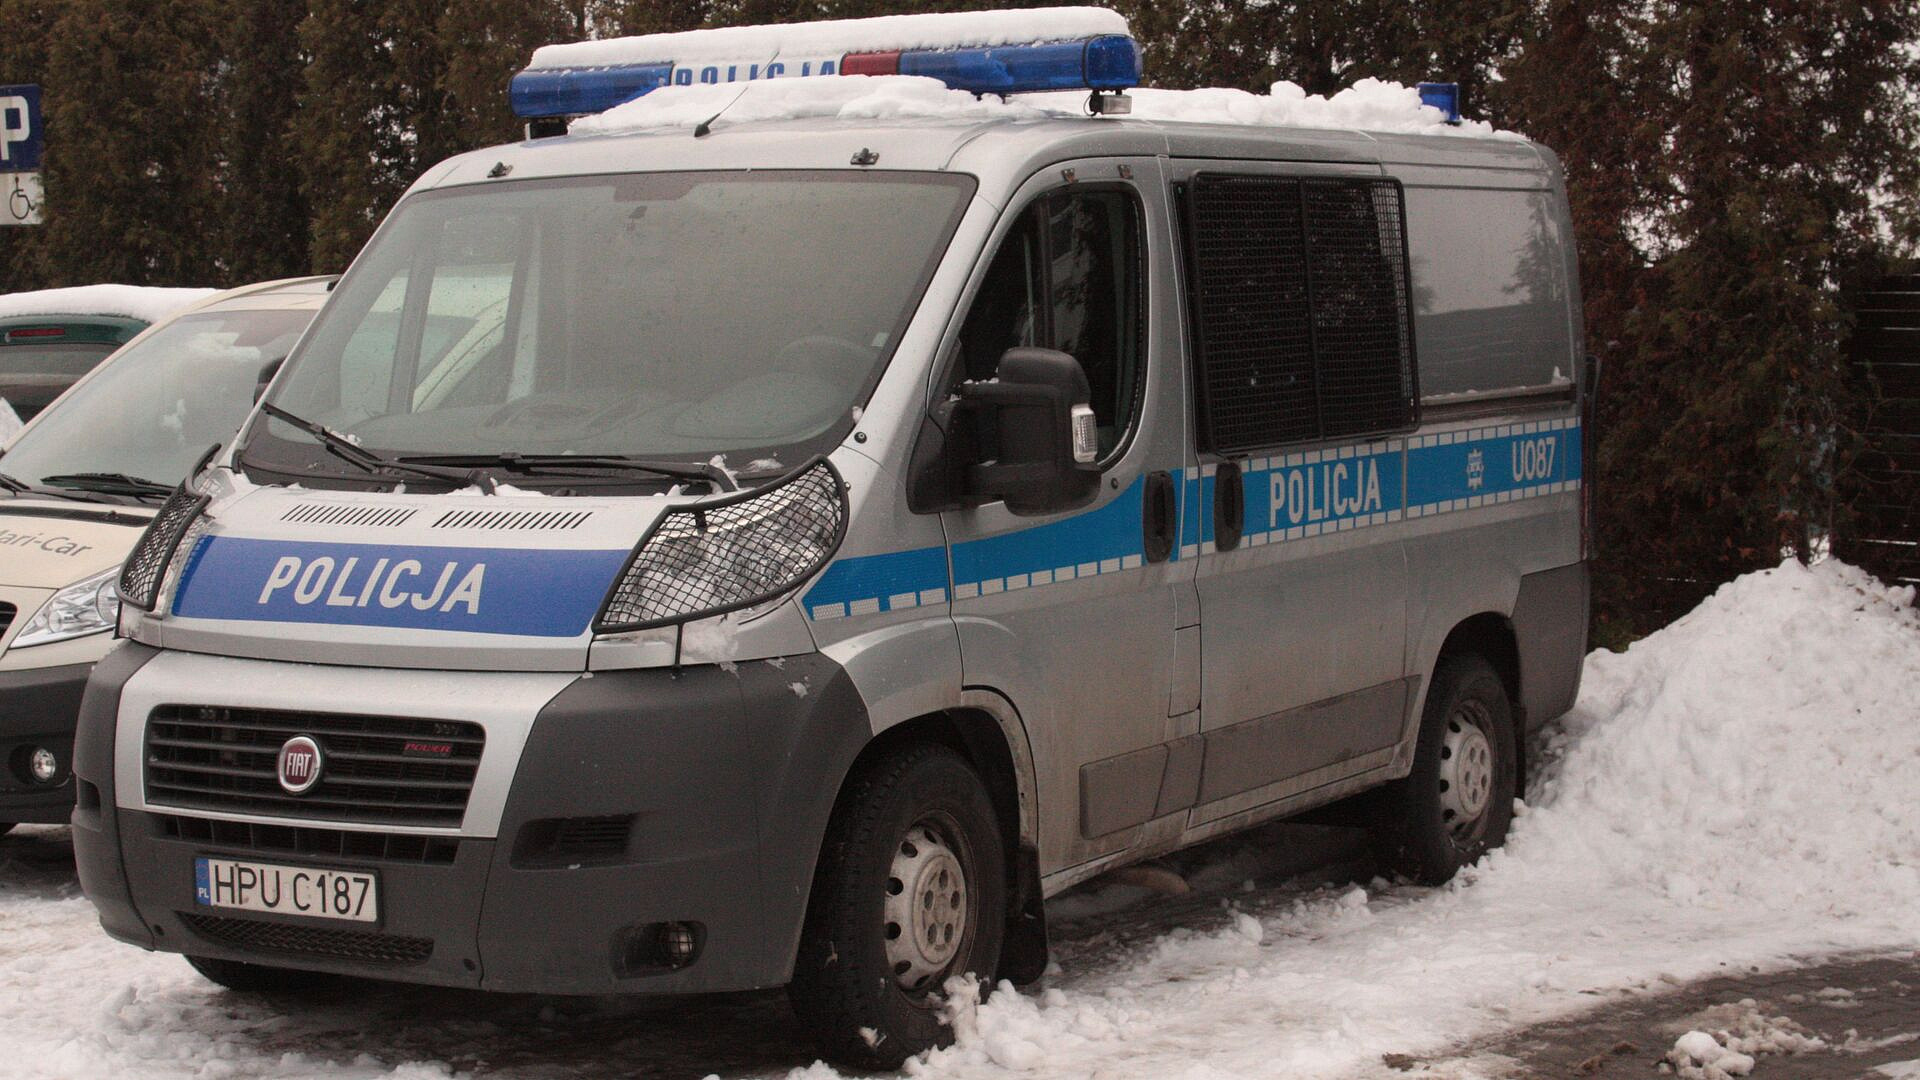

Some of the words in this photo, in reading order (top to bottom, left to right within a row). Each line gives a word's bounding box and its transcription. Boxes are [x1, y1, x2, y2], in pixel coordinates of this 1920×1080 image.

[0, 95, 30, 160] P
[1512, 436, 1556, 482] U087
[1269, 458, 1382, 527] POLICJA
[0, 529, 93, 557] ari-Car
[258, 556, 486, 614] POLICJA
[286, 751, 312, 777] FIAT
[198, 887, 209, 899] PL
[214, 864, 280, 908] HPU
[293, 872, 370, 916] C187
